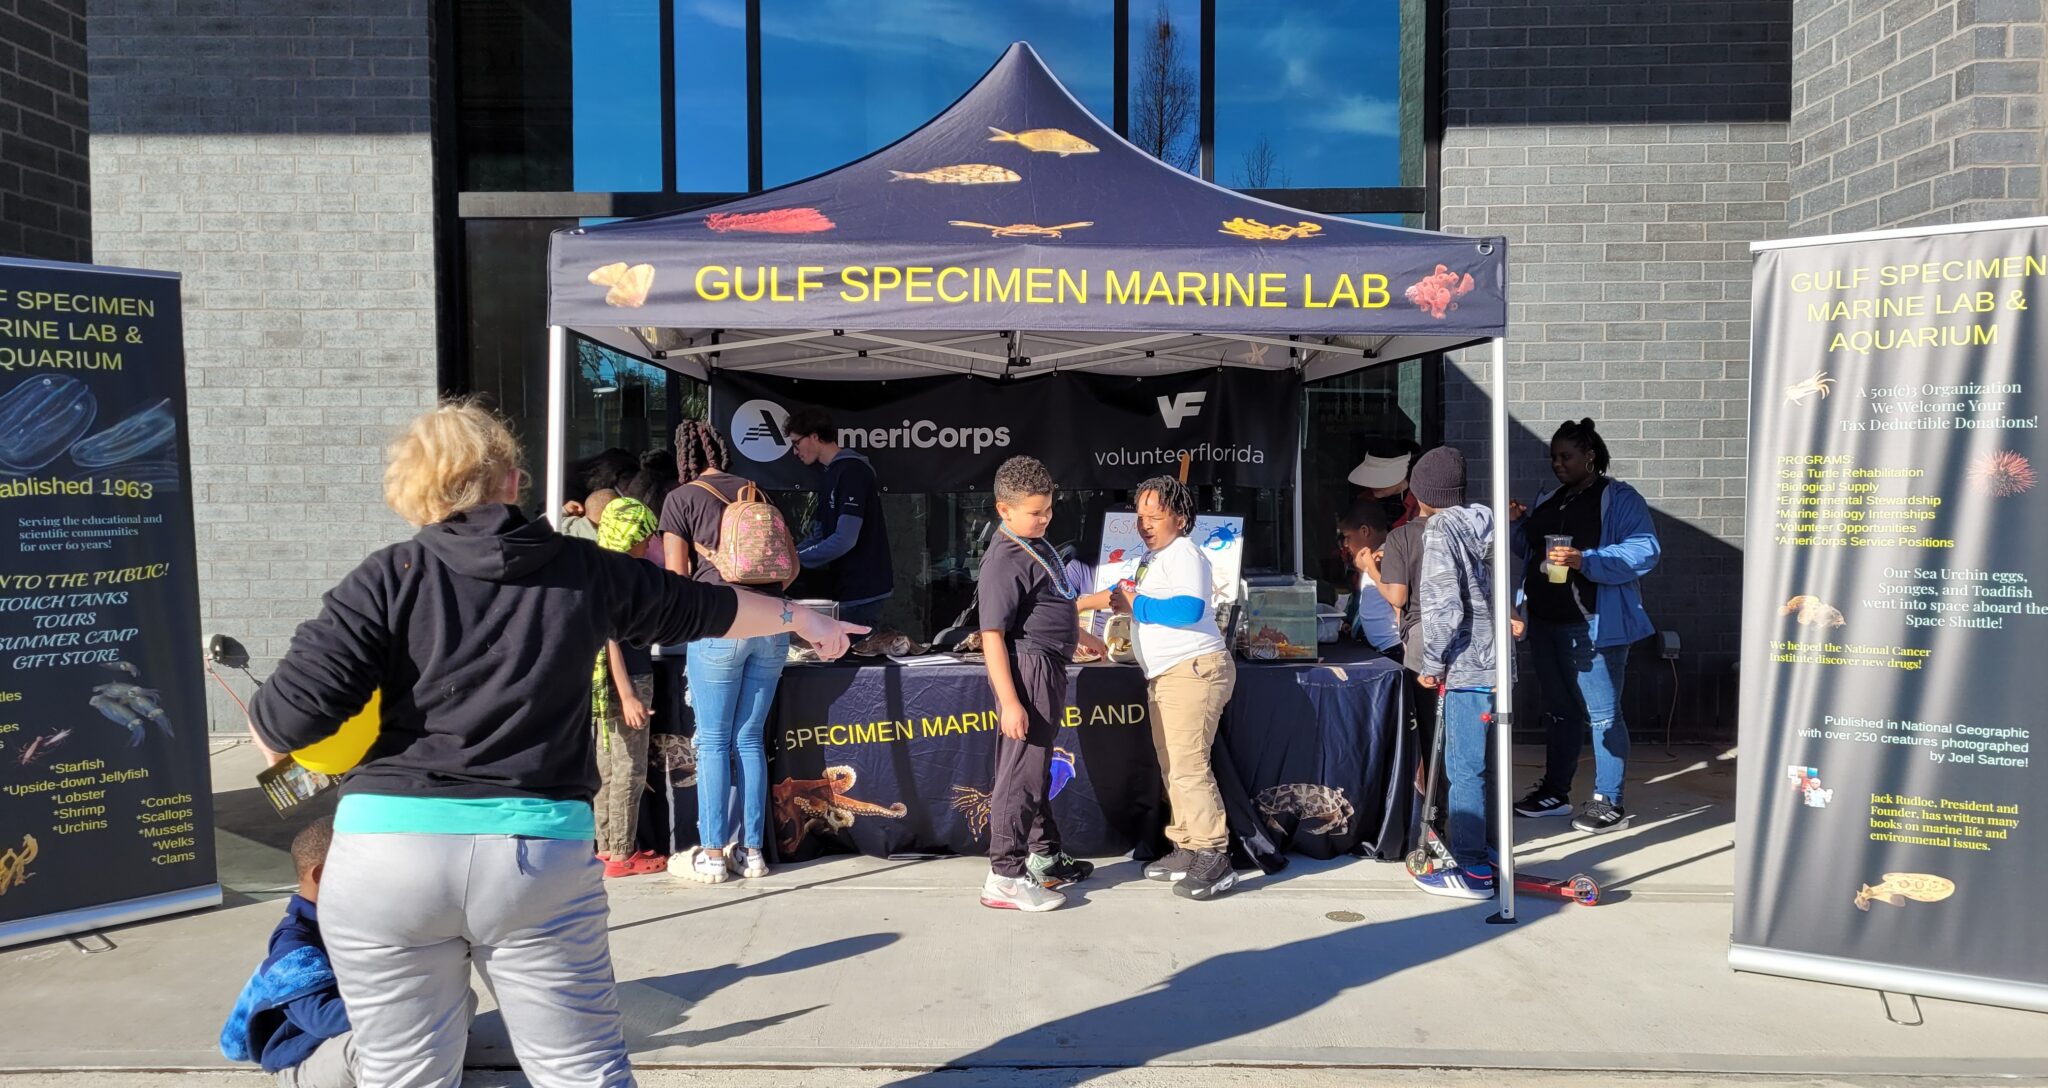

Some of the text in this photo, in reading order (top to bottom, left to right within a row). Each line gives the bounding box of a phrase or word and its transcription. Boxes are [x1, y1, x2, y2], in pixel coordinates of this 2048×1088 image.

[1790, 255, 2048, 293] GULF SPECIMEN
[695, 265, 1391, 309] GULF SPECIMEN MARINE LAB
[17, 290, 155, 317] SPECIMEN
[1807, 289, 2028, 322] MARINE LAB &
[68, 322, 117, 342] LAB
[125, 326, 143, 344] &
[1829, 324, 1999, 355] AQUARIUM
[1856, 382, 2022, 399] A 501(c)3 Organization
[1157, 391, 1207, 428] VF
[1871, 399, 2005, 414] We Welcome Your
[1840, 415, 2038, 431] Tax Deductible Donations!
[837, 419, 1011, 454] meriCorps
[1095, 442, 1264, 466] volunteerflorida
[1777, 455, 1855, 465] PROGRAMS:
[1807, 468, 1839, 478] Turtle
[1842, 467, 1924, 478] Rehabilitation
[101, 478, 153, 500] 1963
[1838, 482, 1879, 493] Supply
[1866, 495, 1941, 507] Stewardship
[18, 513, 163, 527] Serving the educational and
[1822, 509, 1865, 520] Biology
[1868, 509, 1936, 521] Internships
[19, 526, 139, 540] scientific communities
[1836, 523, 1917, 535] Opportunities
[20, 539, 112, 552] for over 60 years!
[1850, 537, 1895, 547] Service
[1899, 537, 1954, 548] Positions
[13, 575, 42, 590] TO
[45, 572, 89, 588] THE
[93, 562, 170, 586] PUBLIC!
[1883, 567, 2028, 583] Our Sea Urchin eggs,
[1878, 582, 2033, 599] Sponges, and Toadfish
[0, 591, 129, 612] TOUCH TANKS
[1862, 598, 2048, 615] went into space aboard the
[33, 612, 96, 629] TOURS
[1906, 614, 2003, 629] Space Shuttle!
[0, 628, 139, 651] SUMMER CAMP
[1769, 640, 1932, 657] We helped the National Cancer
[13, 648, 120, 670] GIFT STORE
[1769, 652, 1922, 670] Institute discover new drugs!
[1090, 704, 1145, 726] AND
[785, 719, 914, 751] SPECIMEN
[1824, 715, 2030, 739] Published in National Geographic
[1797, 727, 2030, 753] with over 250 creatures photographed
[1929, 750, 2029, 767] by Joel Sartore!
[99, 767, 149, 784] Jellyfish
[1870, 793, 1893, 804] Jack
[1940, 798, 1994, 812] President
[1996, 804, 2019, 814] and
[1922, 810, 1941, 820] has
[1943, 812, 1984, 825] written
[1987, 817, 2020, 829] many
[1870, 818, 2007, 840] books on marine life and
[1870, 831, 1991, 851] environmental issues.
